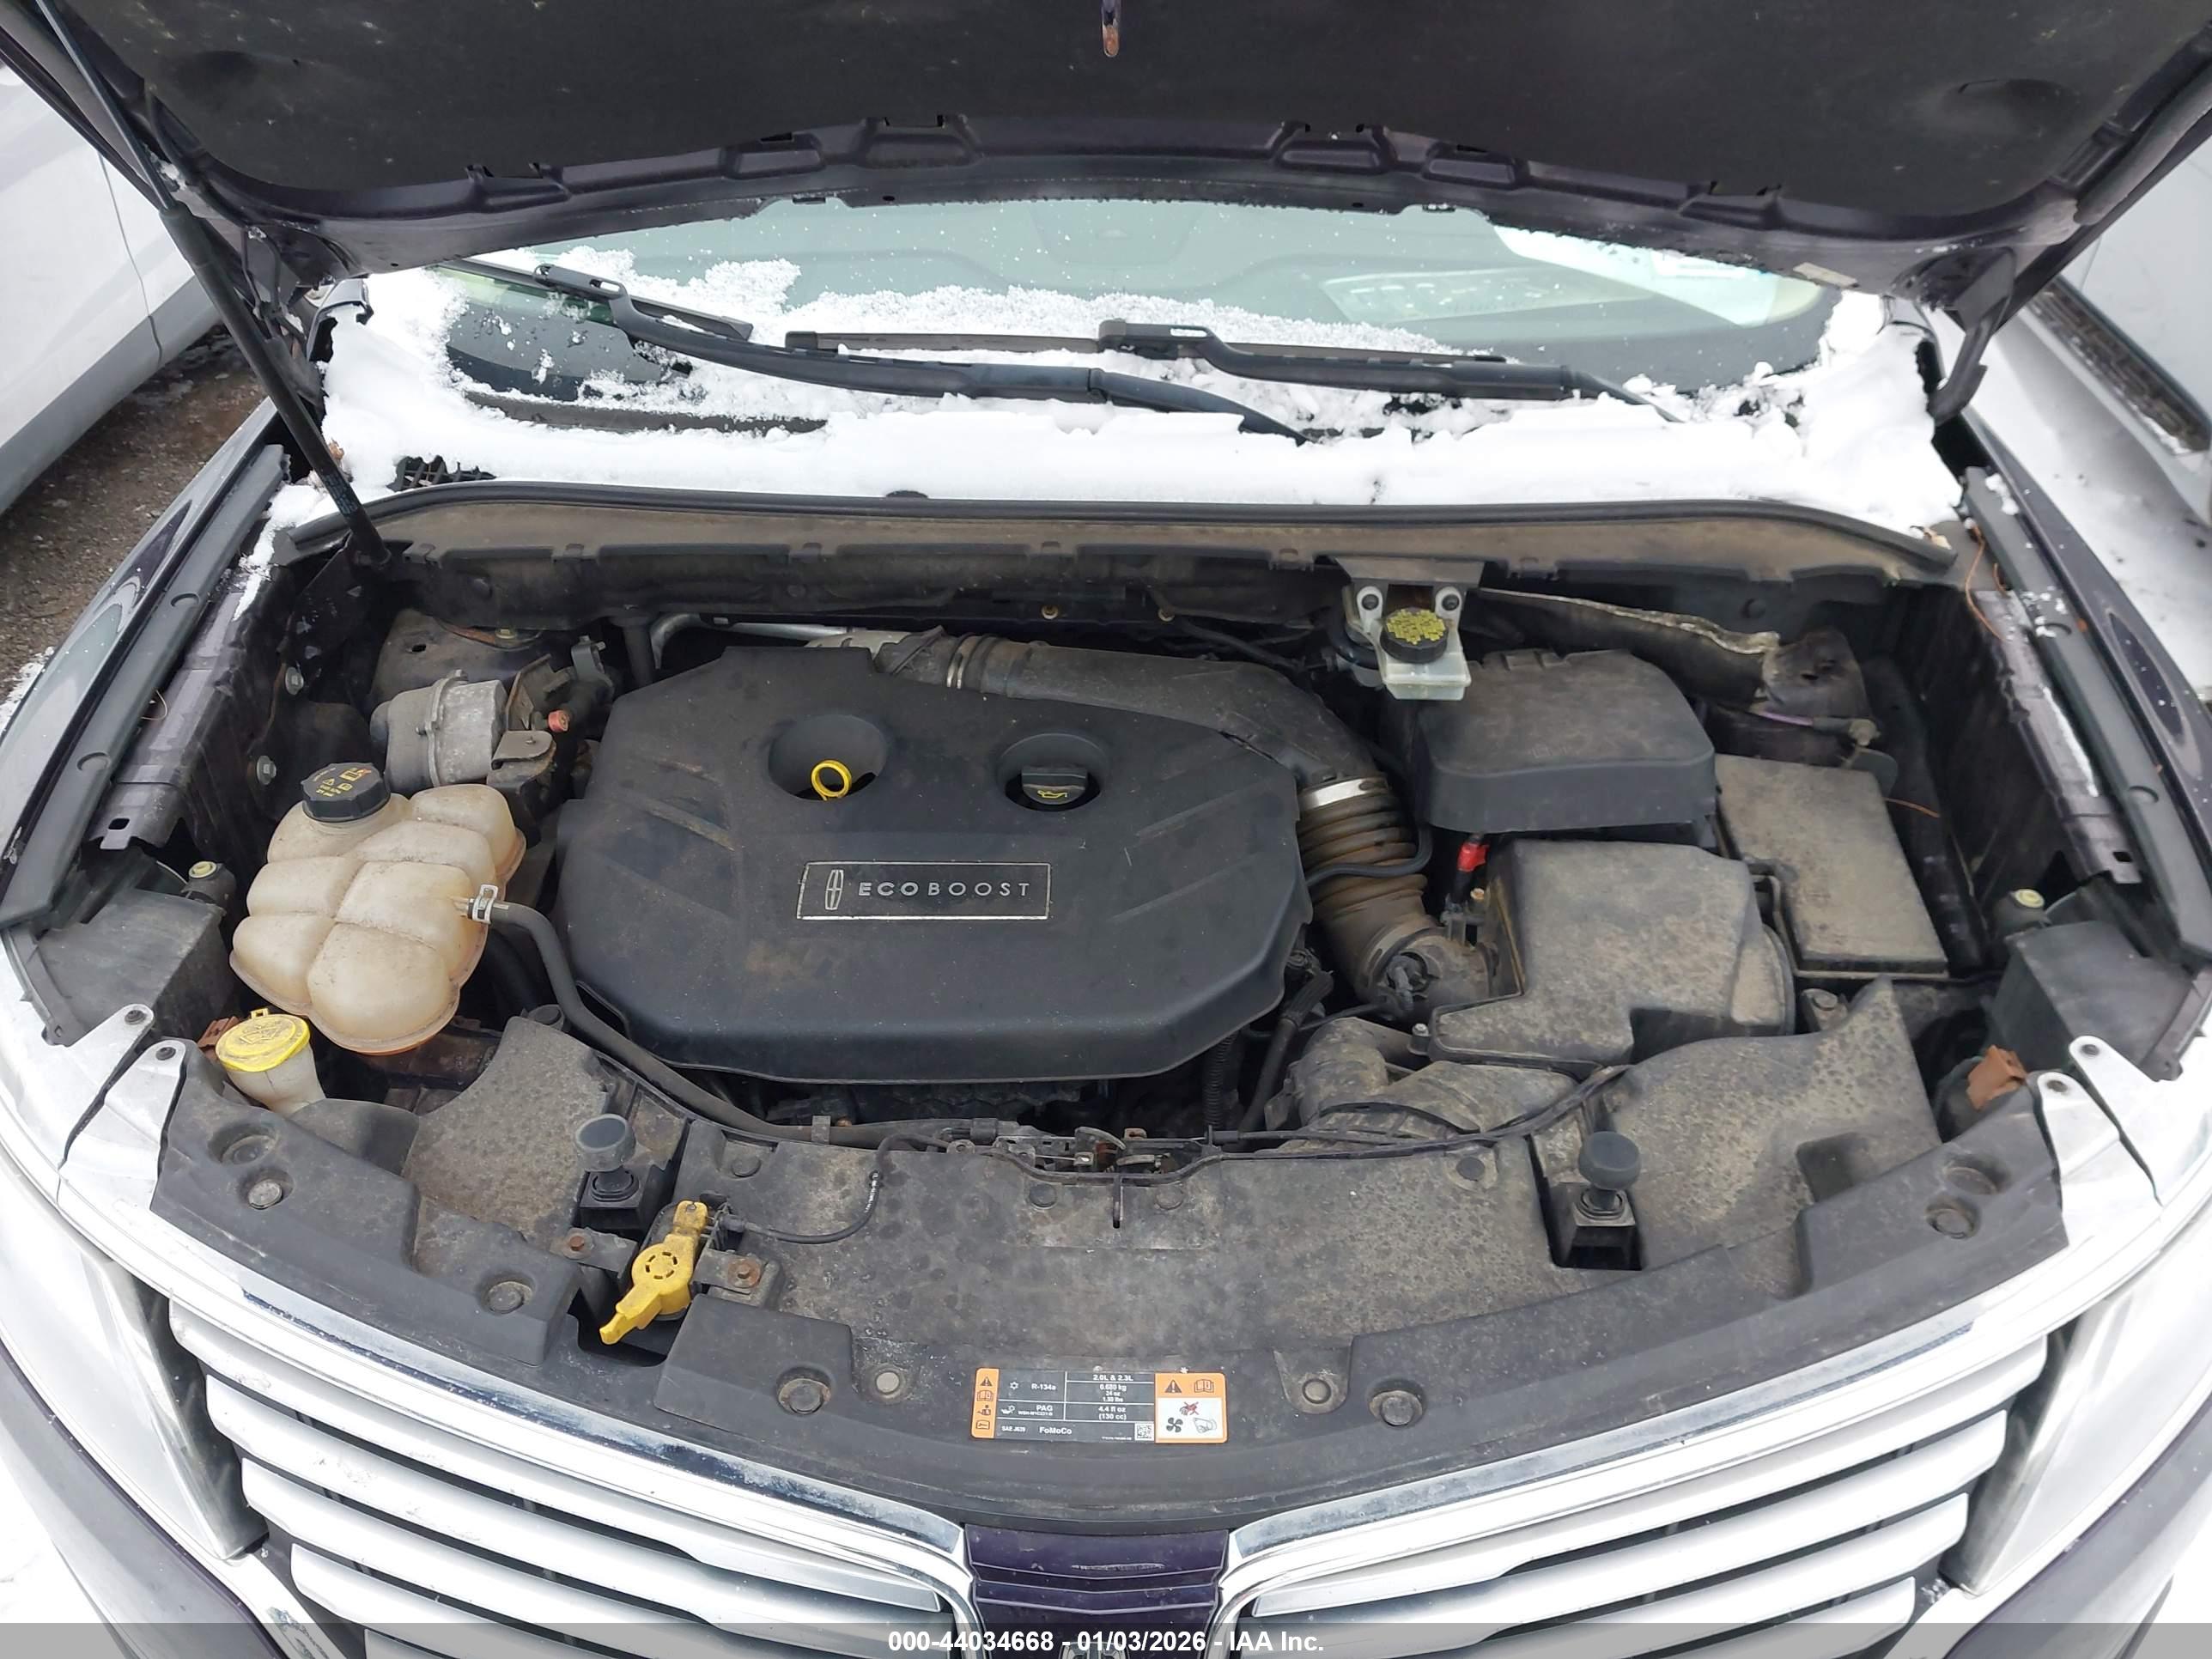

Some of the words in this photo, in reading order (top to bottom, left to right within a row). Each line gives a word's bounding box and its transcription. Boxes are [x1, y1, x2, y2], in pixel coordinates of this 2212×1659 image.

[859, 882, 1030, 896] ECOBOOST
[1118, 1383, 1127, 1392] kg
[1039, 1426, 1073, 1435] FoMoCo
